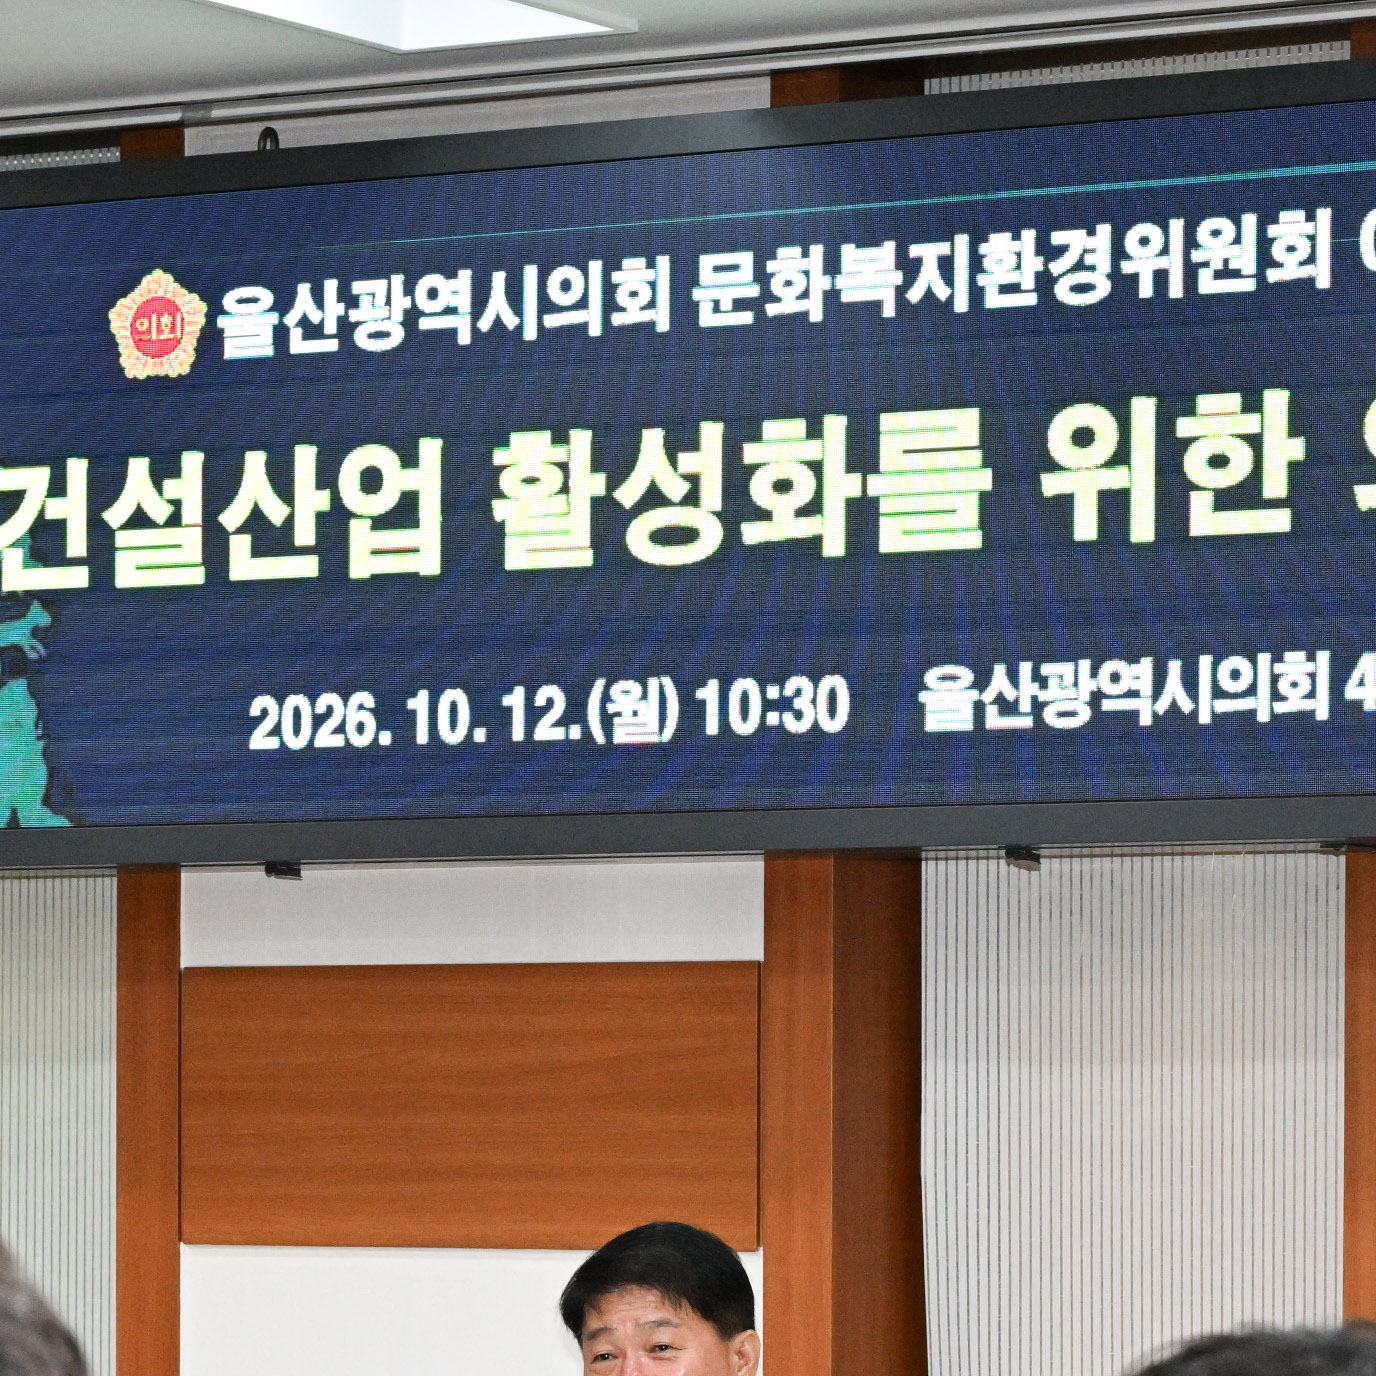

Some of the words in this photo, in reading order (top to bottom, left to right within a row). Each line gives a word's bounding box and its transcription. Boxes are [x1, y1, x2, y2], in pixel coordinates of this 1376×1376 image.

[216, 253, 672, 361] 울산광역시의회
[691, 206, 1333, 328] 문화복지환경위원회
[490, 405, 994, 572] 활성화를
[1038, 386, 1307, 544] 위한
[247, 689, 393, 751] 2026.
[405, 687, 488, 745] 10.
[501, 675, 681, 745] 12.(월)
[694, 673, 851, 736] 10:30
[916, 650, 1331, 732] 울산광역시의회
